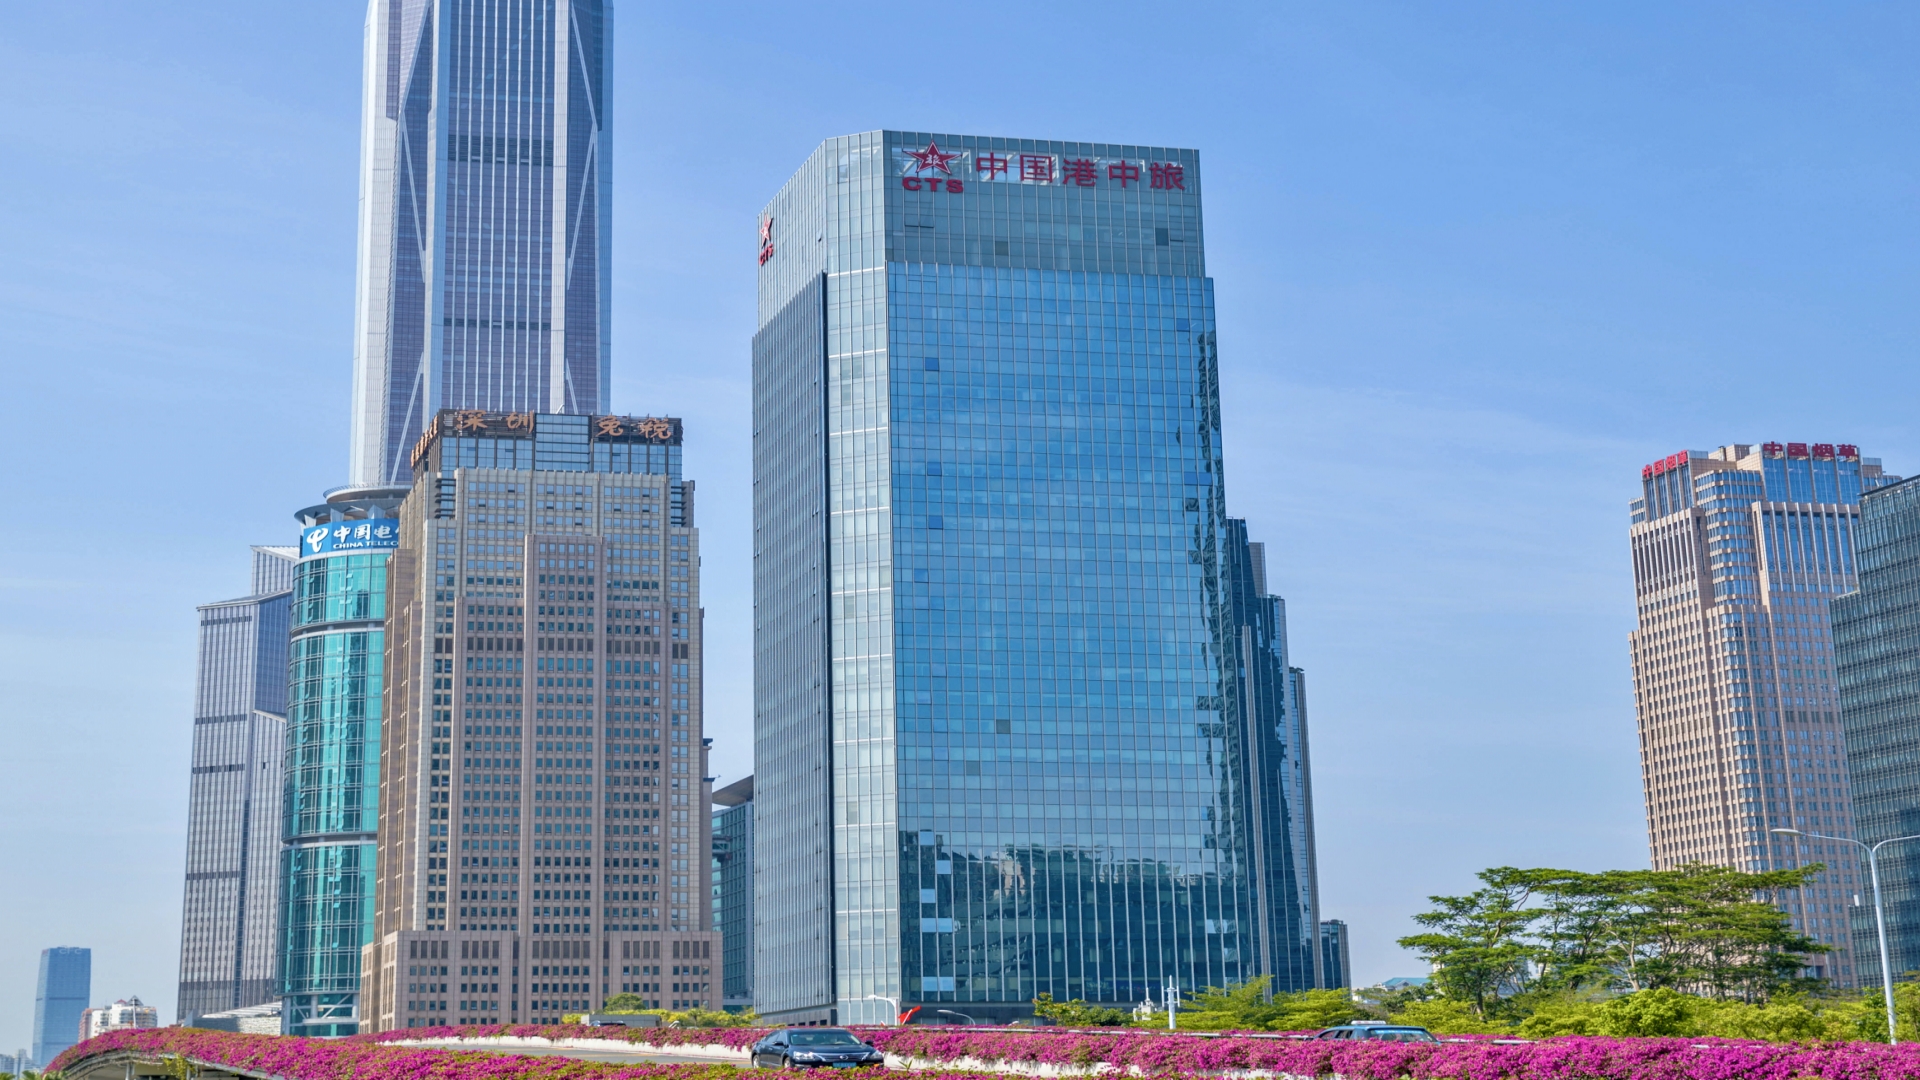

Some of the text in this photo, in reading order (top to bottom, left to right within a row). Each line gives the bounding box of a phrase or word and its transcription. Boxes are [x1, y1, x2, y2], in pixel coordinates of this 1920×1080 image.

[975, 151, 1186, 191] 中国港中旅
[902, 176, 964, 193] CTS
[594, 414, 672, 440] 免税
[333, 541, 364, 549] CHINA
